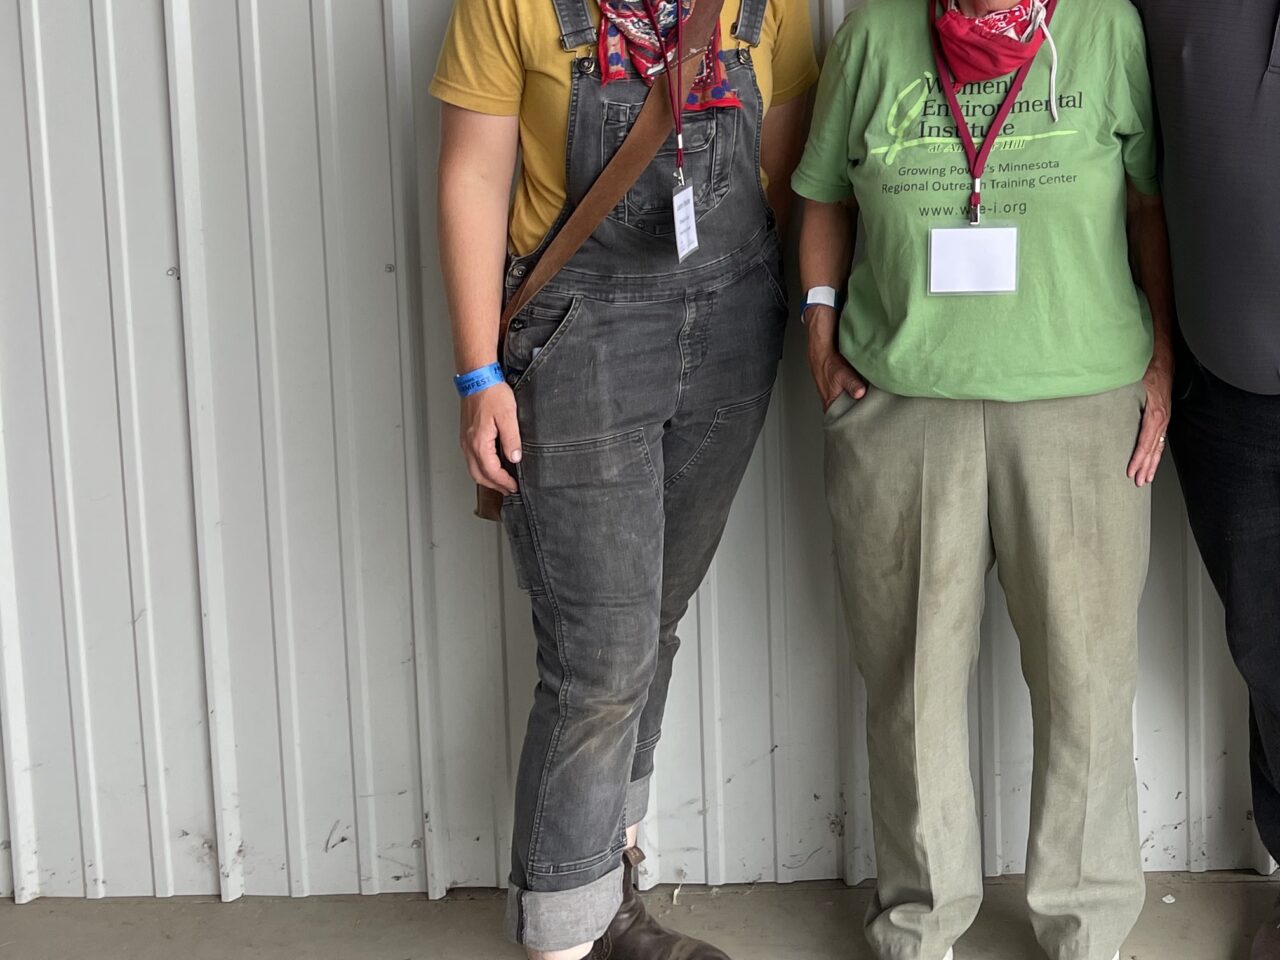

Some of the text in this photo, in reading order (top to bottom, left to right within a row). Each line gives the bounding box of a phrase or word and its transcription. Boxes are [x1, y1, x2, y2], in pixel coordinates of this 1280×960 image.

[1000, 139, 1026, 150] Hill
[898, 166, 946, 178] Growing
[999, 159, 1060, 173] Minnesota
[882, 181, 929, 195] Regional
[990, 176, 1036, 189] Training
[1038, 173, 1079, 185] Center
